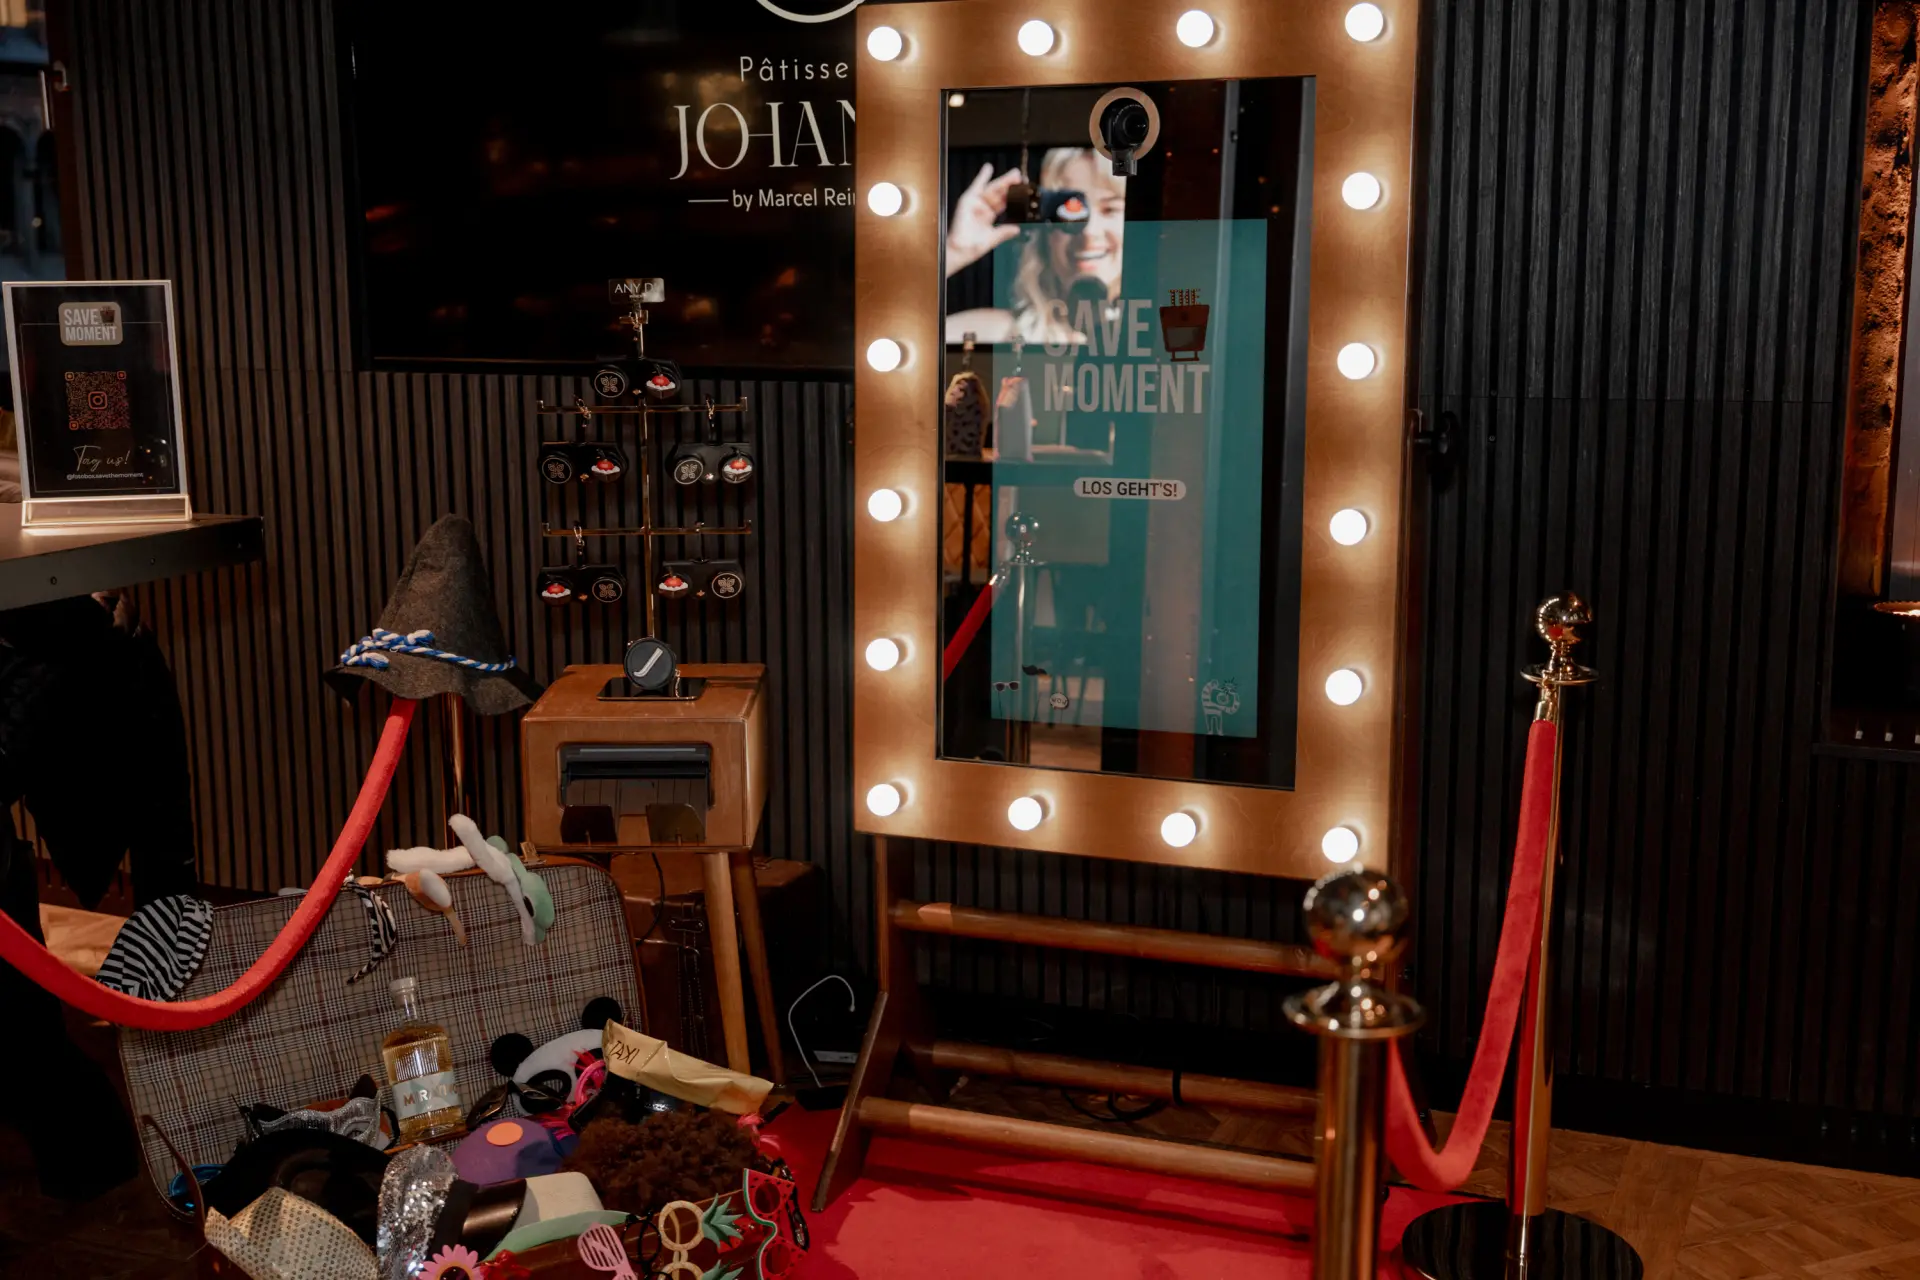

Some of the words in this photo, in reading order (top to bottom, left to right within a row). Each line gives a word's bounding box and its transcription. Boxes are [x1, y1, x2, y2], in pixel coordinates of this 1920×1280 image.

[732, 189, 753, 212] by
[758, 188, 818, 207] Marcel
[614, 283, 640, 294] ANY
[64, 308, 99, 326] SAVE
[1043, 299, 1153, 357] SAVE
[65, 325, 117, 341] MOMENT
[1043, 362, 1210, 414] MOMENT
[73, 445, 101, 472] Tag
[106, 450, 131, 466] us!
[1082, 480, 1112, 495] LOS
[1117, 481, 1178, 497] GEHT'S!
[608, 1040, 640, 1065] TAXI
